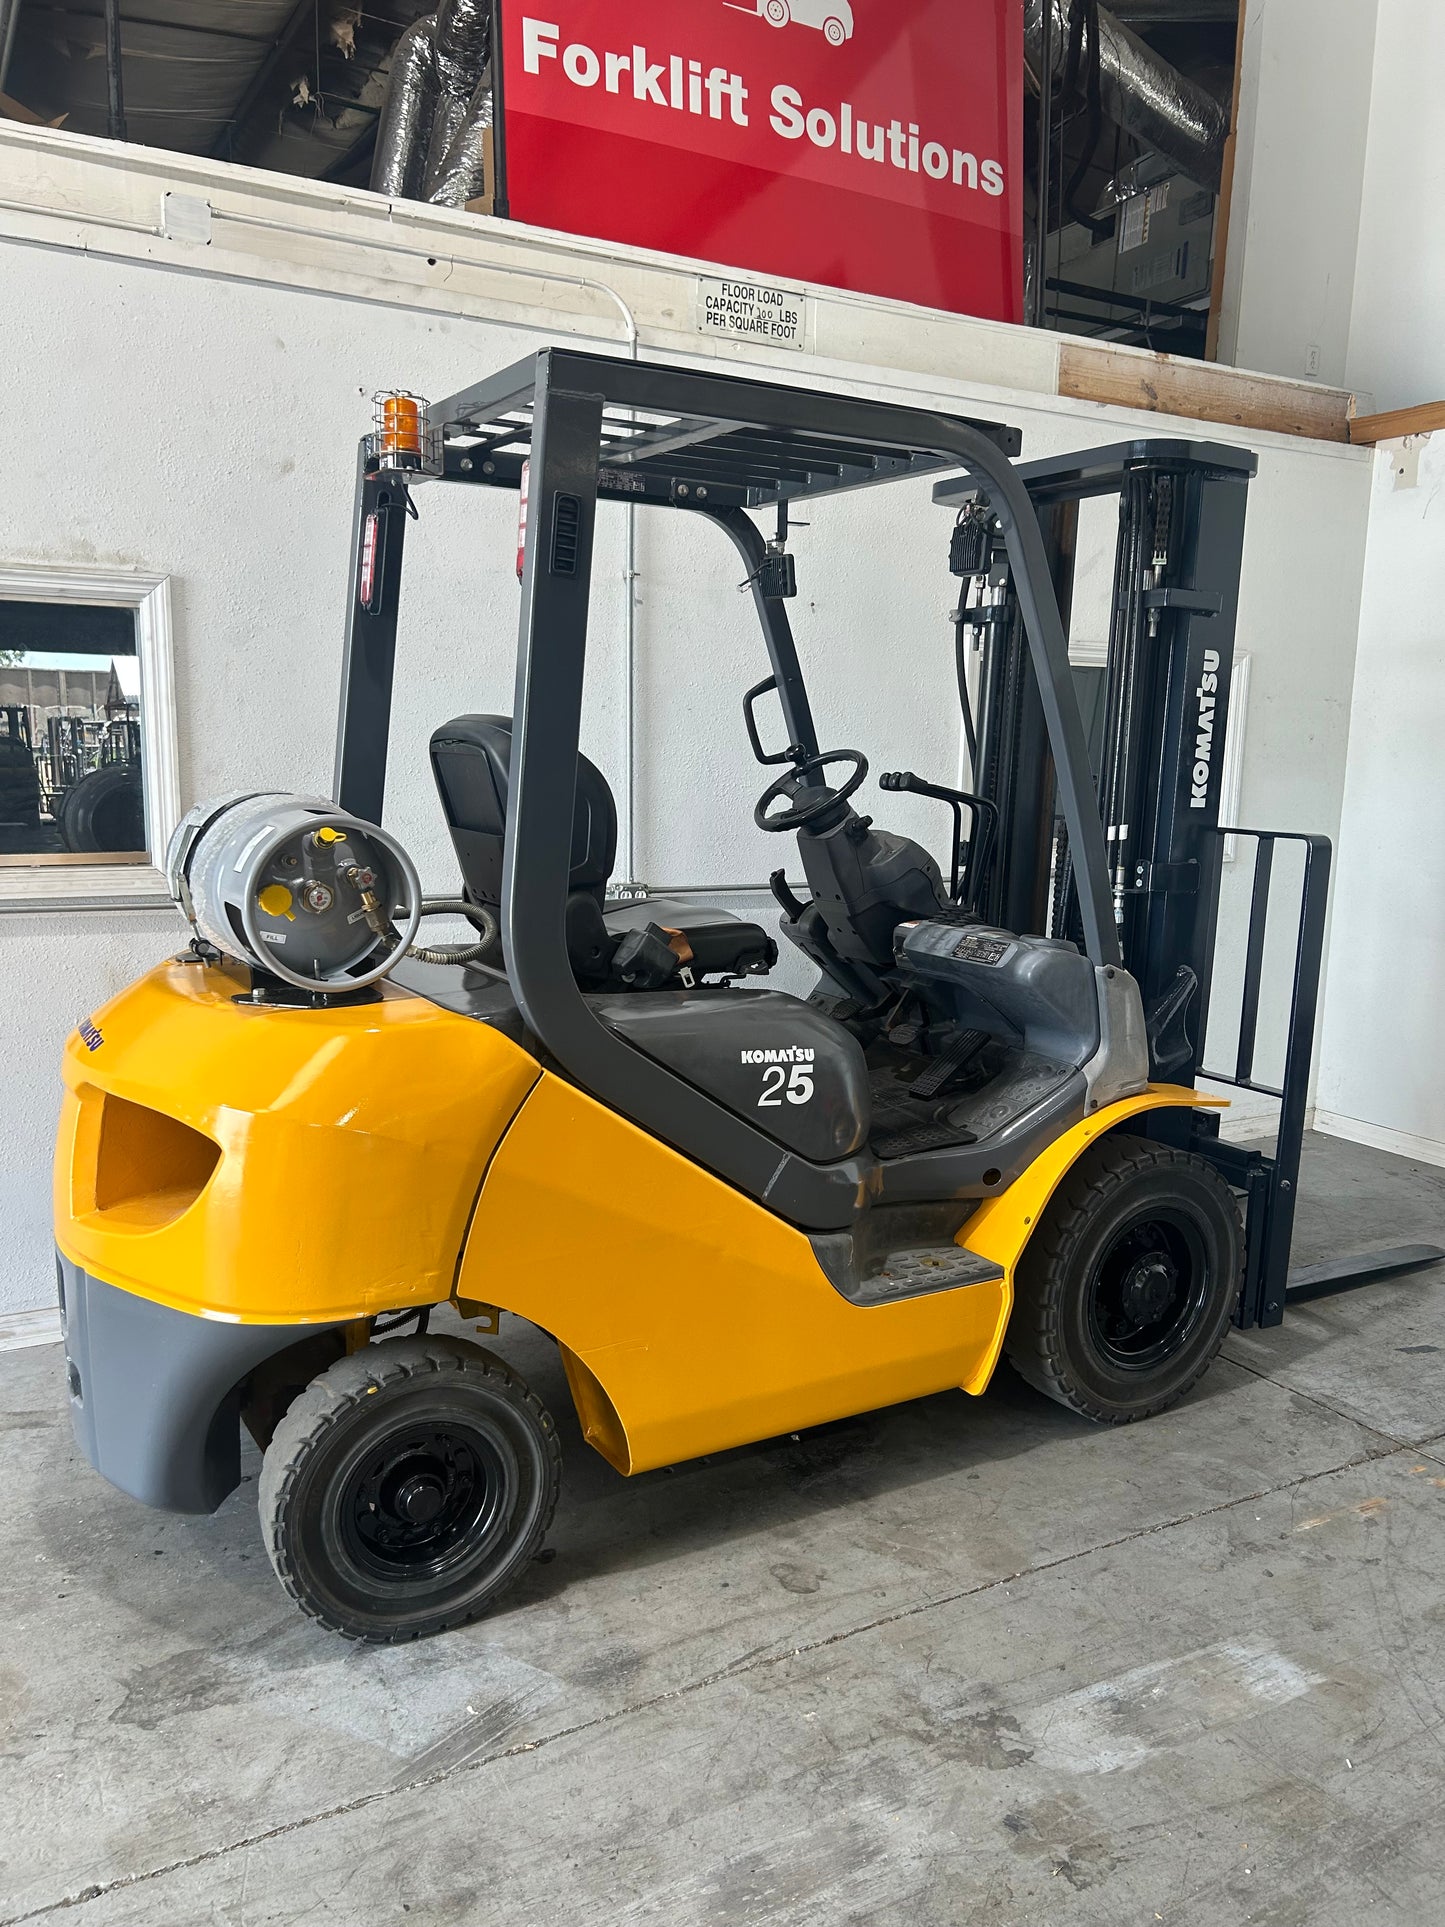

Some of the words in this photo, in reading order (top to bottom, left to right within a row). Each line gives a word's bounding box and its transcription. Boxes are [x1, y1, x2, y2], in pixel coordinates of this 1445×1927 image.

[522, 16, 749, 127] Forklift
[769, 84, 1005, 197] Solutions
[722, 283, 755, 301] FLOOR
[757, 289, 783, 306] LOAD
[706, 295, 755, 316] CAPACITY
[779, 309, 798, 324] LBS
[706, 311, 726, 327] PER
[729, 315, 769, 334] SQUARE
[771, 323, 797, 339] FOOT
[1190, 649, 1220, 808] KOMATSU
[741, 1045, 815, 1064] KOMATSU
[757, 1064, 814, 1106] 25
